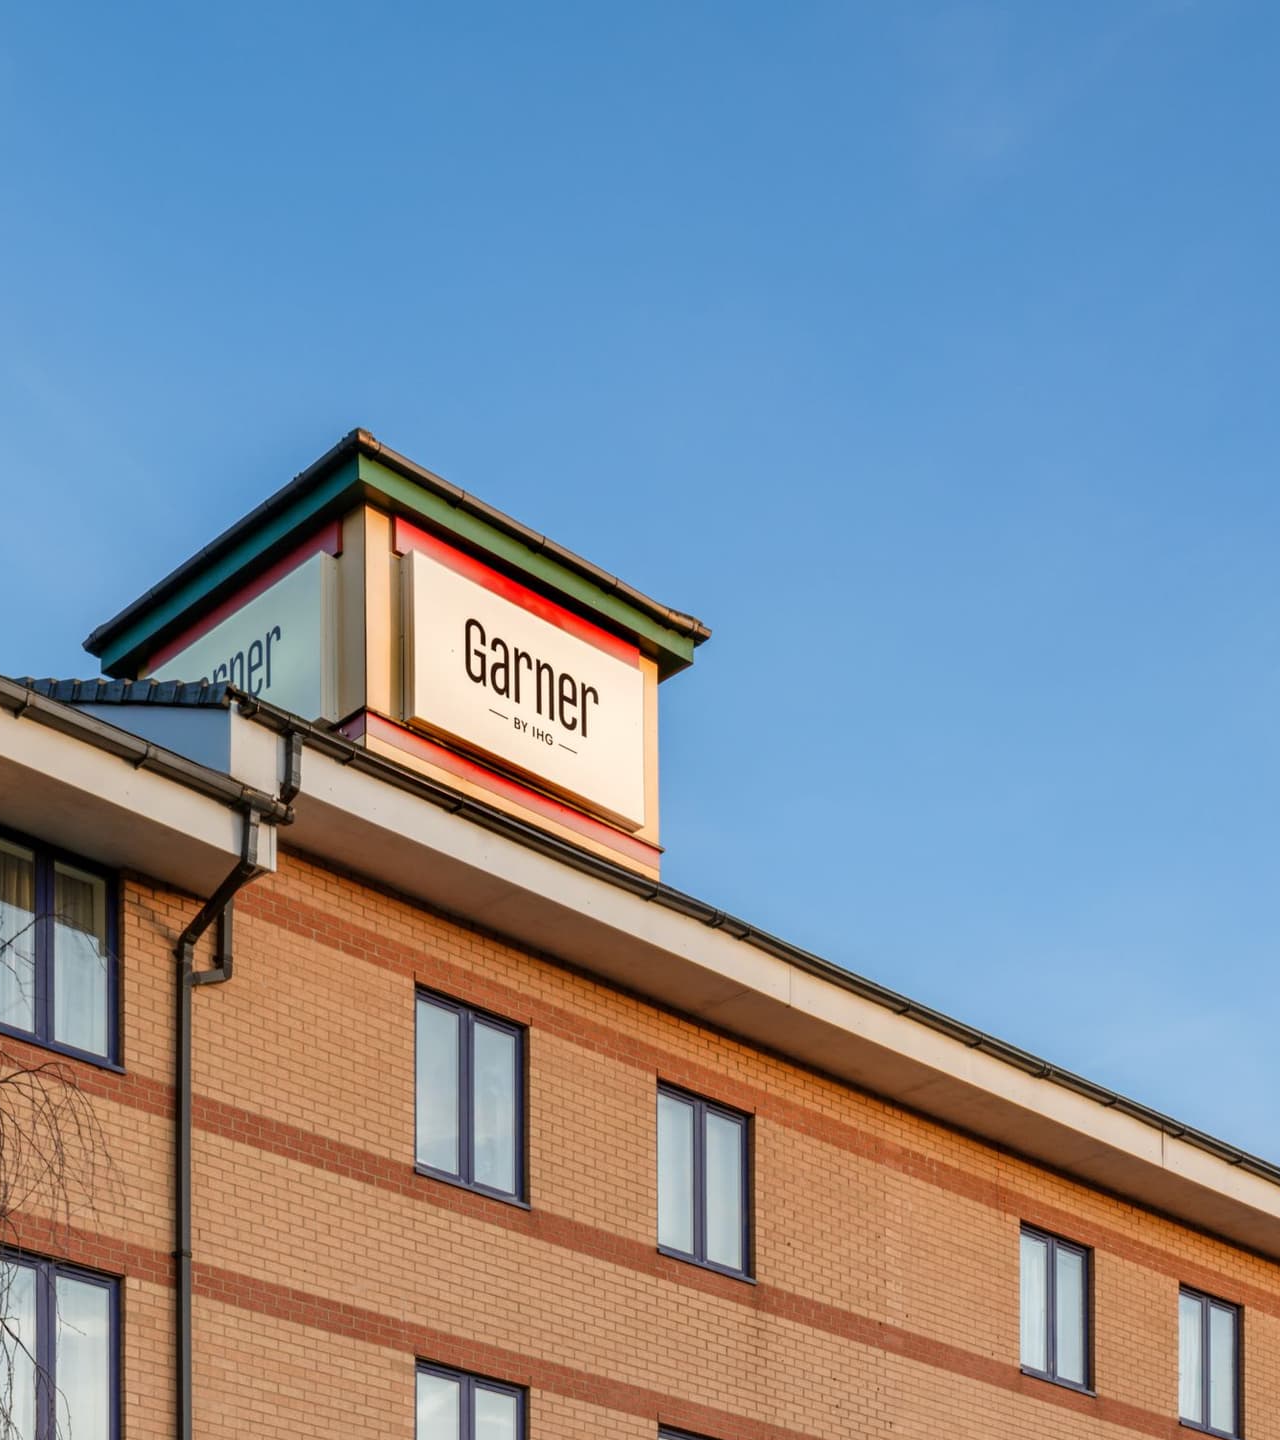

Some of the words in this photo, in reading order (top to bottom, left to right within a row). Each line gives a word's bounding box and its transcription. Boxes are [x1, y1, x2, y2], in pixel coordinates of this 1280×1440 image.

[464, 618, 599, 738] Garner
[513, 717, 528, 733] BY
[532, 726, 554, 746] IHG
